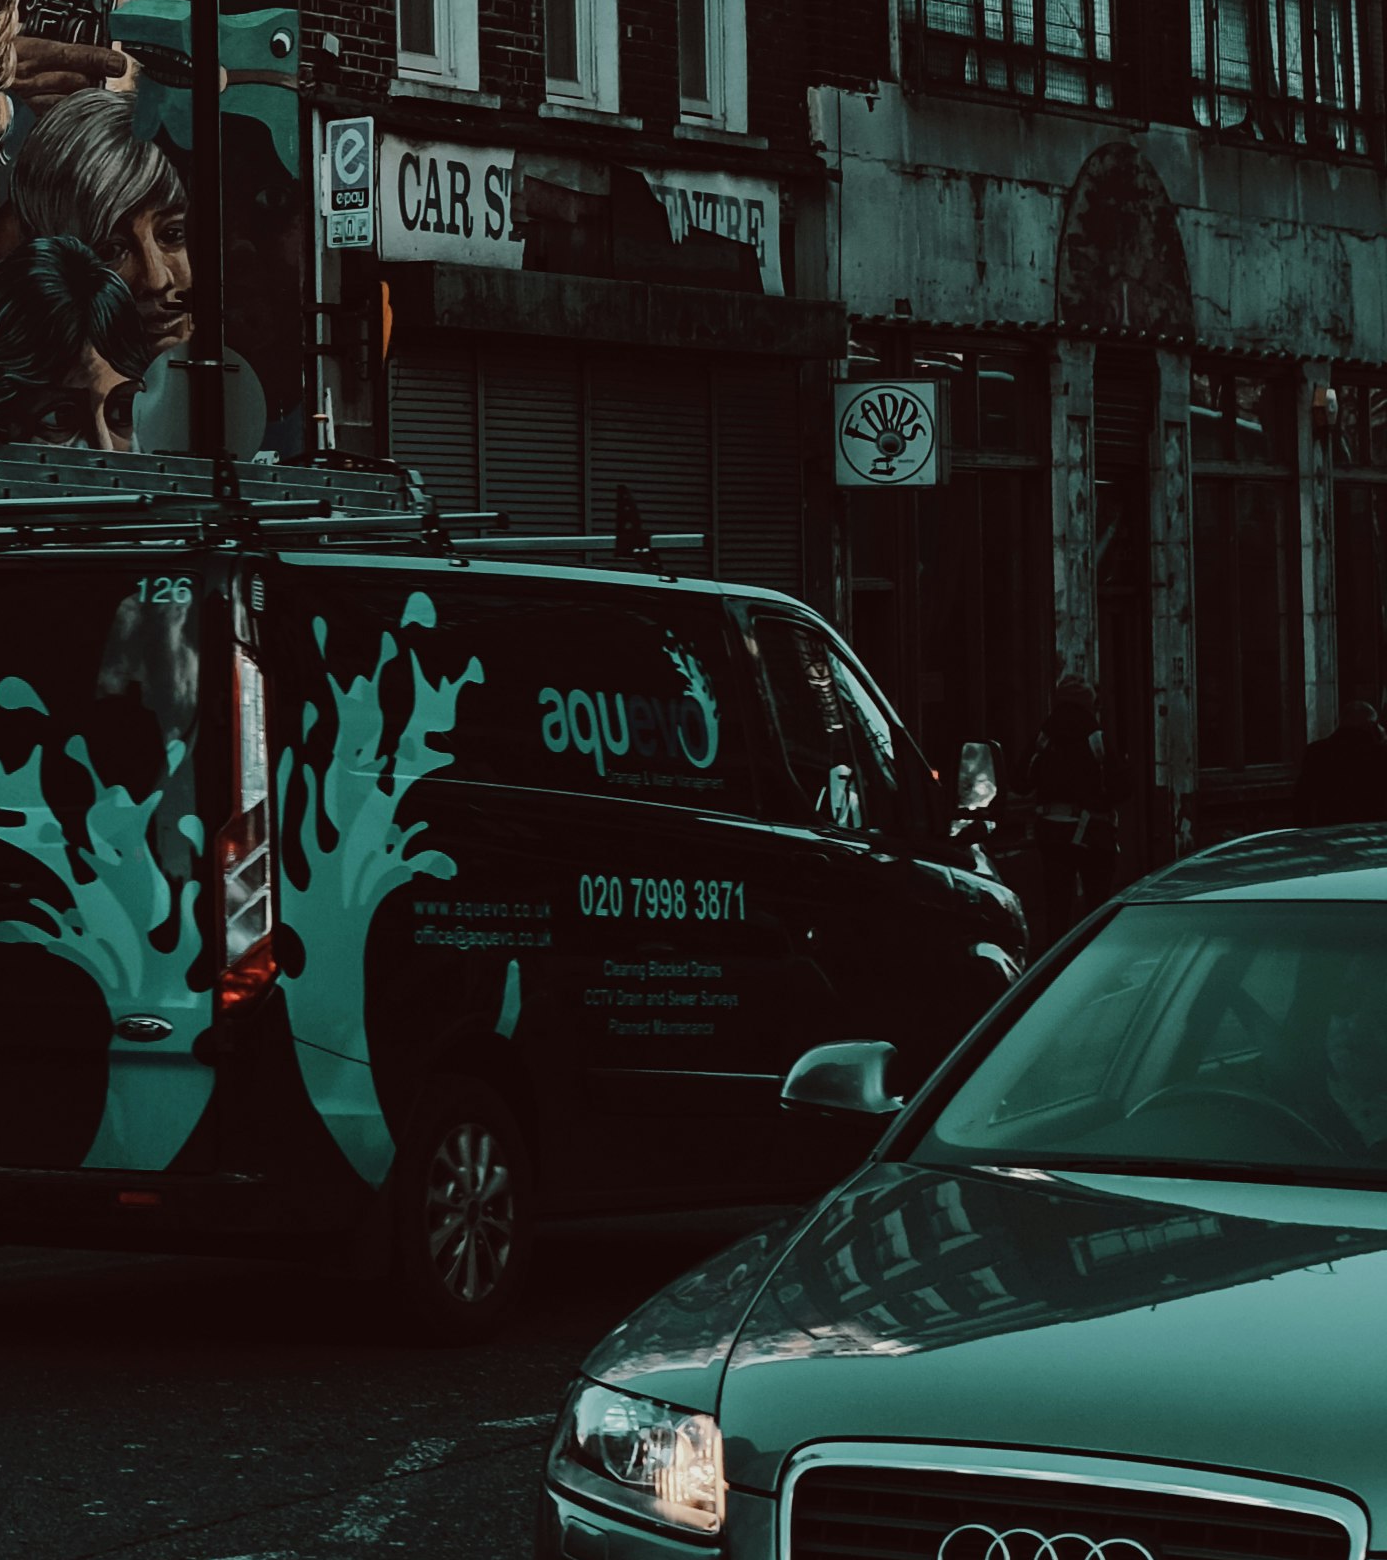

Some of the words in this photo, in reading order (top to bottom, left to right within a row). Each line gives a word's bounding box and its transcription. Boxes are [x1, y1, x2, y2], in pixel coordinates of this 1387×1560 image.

[335, 191, 365, 207] epay
[398, 151, 474, 239] CAR
[136, 577, 193, 604] 126
[538, 686, 720, 777] aquevo
[579, 874, 624, 918] 020
[631, 877, 689, 920] 7998
[693, 879, 747, 921] 3871
[412, 900, 553, 921] www.aquevo.co.uk
[648, 960, 688, 978] Blocked
[646, 991, 666, 1007] and
